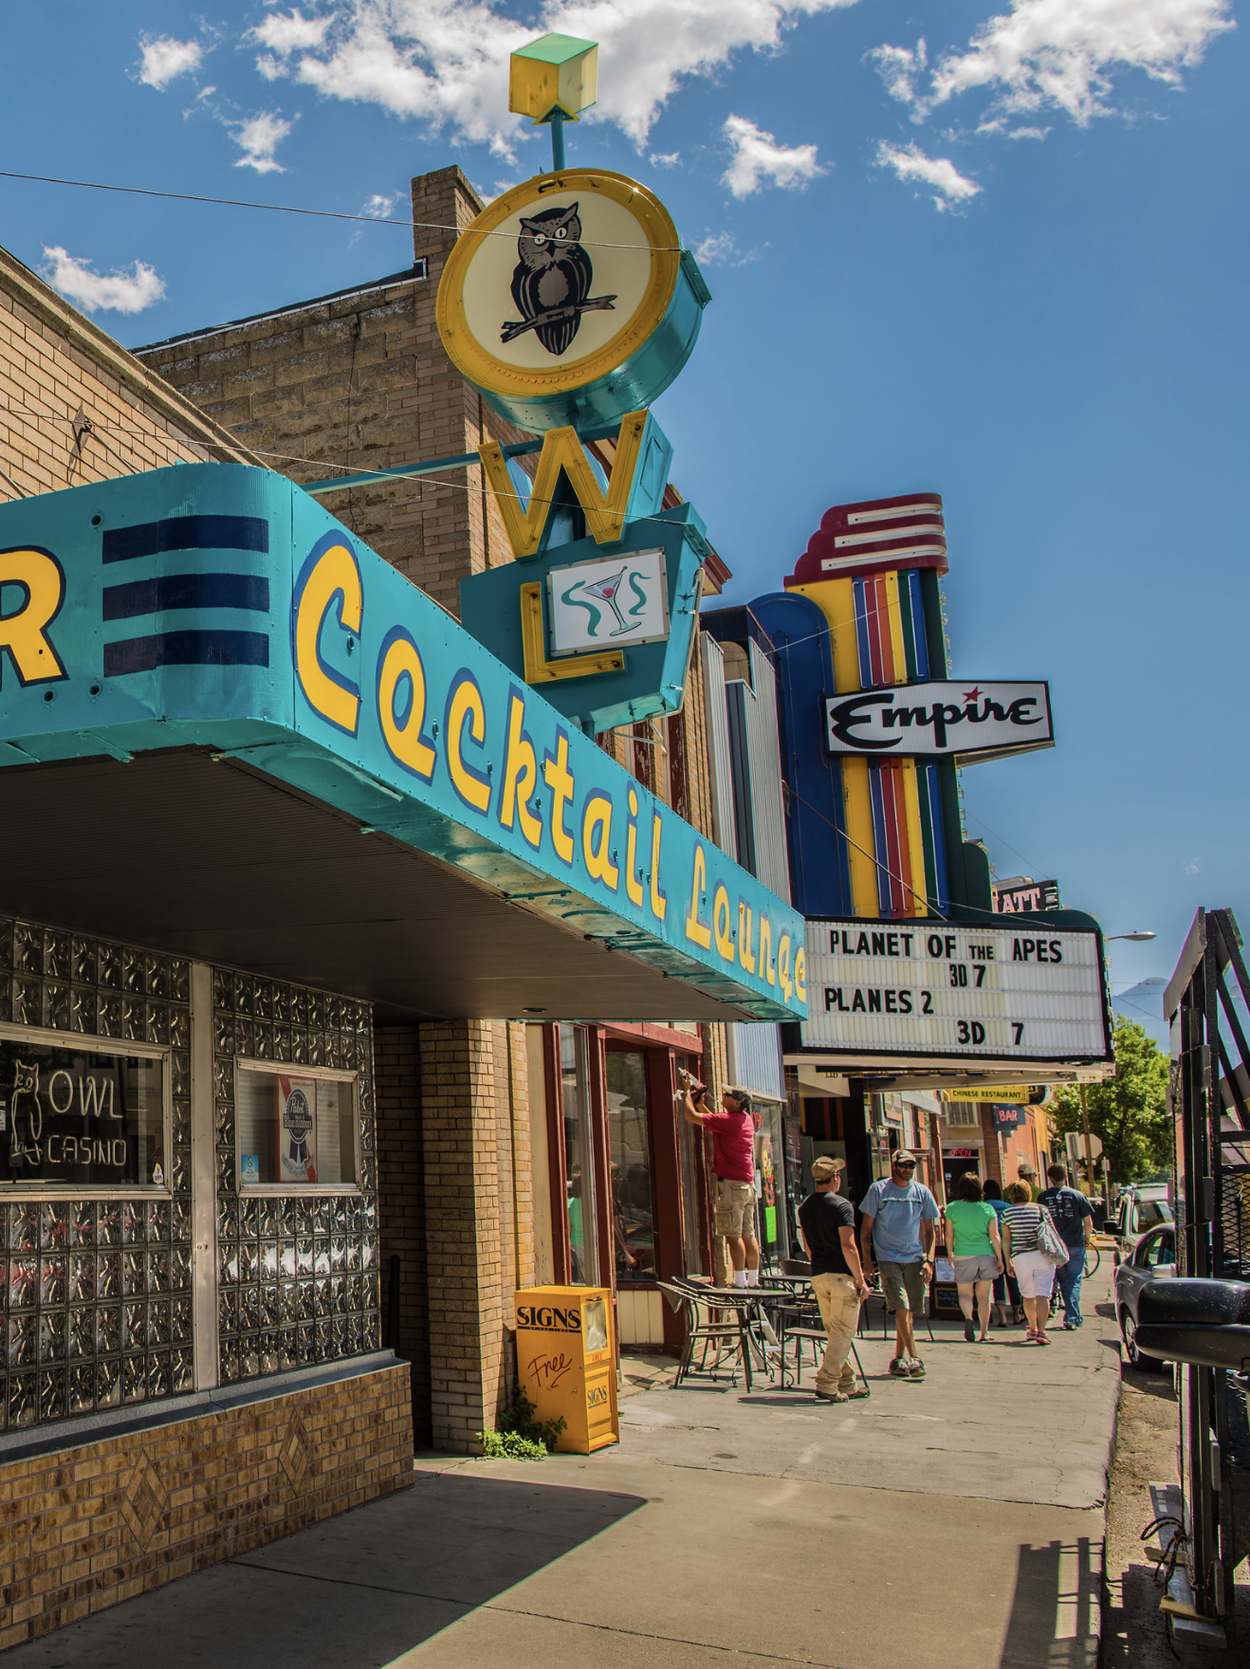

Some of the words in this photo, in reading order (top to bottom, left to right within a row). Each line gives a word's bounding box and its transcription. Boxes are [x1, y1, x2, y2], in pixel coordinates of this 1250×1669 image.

[829, 684, 1044, 749] Empire
[291, 529, 666, 921] Cocktail
[685, 838, 806, 1004] Lounge
[830, 930, 913, 957] PLANET
[927, 934, 956, 958] OF
[969, 945, 994, 960] THE
[1012, 938, 1062, 963] APES
[950, 964, 968, 988] 3D
[973, 965, 986, 988] 7
[824, 987, 913, 1014] PLANES
[920, 990, 934, 1015] 2
[957, 1020, 986, 1045] 3D
[1011, 1022, 1024, 1045] 7
[49, 1070, 124, 1119] OWL
[999, 1109, 1018, 1122] BAR
[48, 1134, 127, 1166] CASINO
[950, 1149, 971, 1157] OPEN
[517, 1306, 582, 1329] SIGNS
[527, 1352, 573, 1387] Free
[587, 1385, 608, 1406] SIGNS
